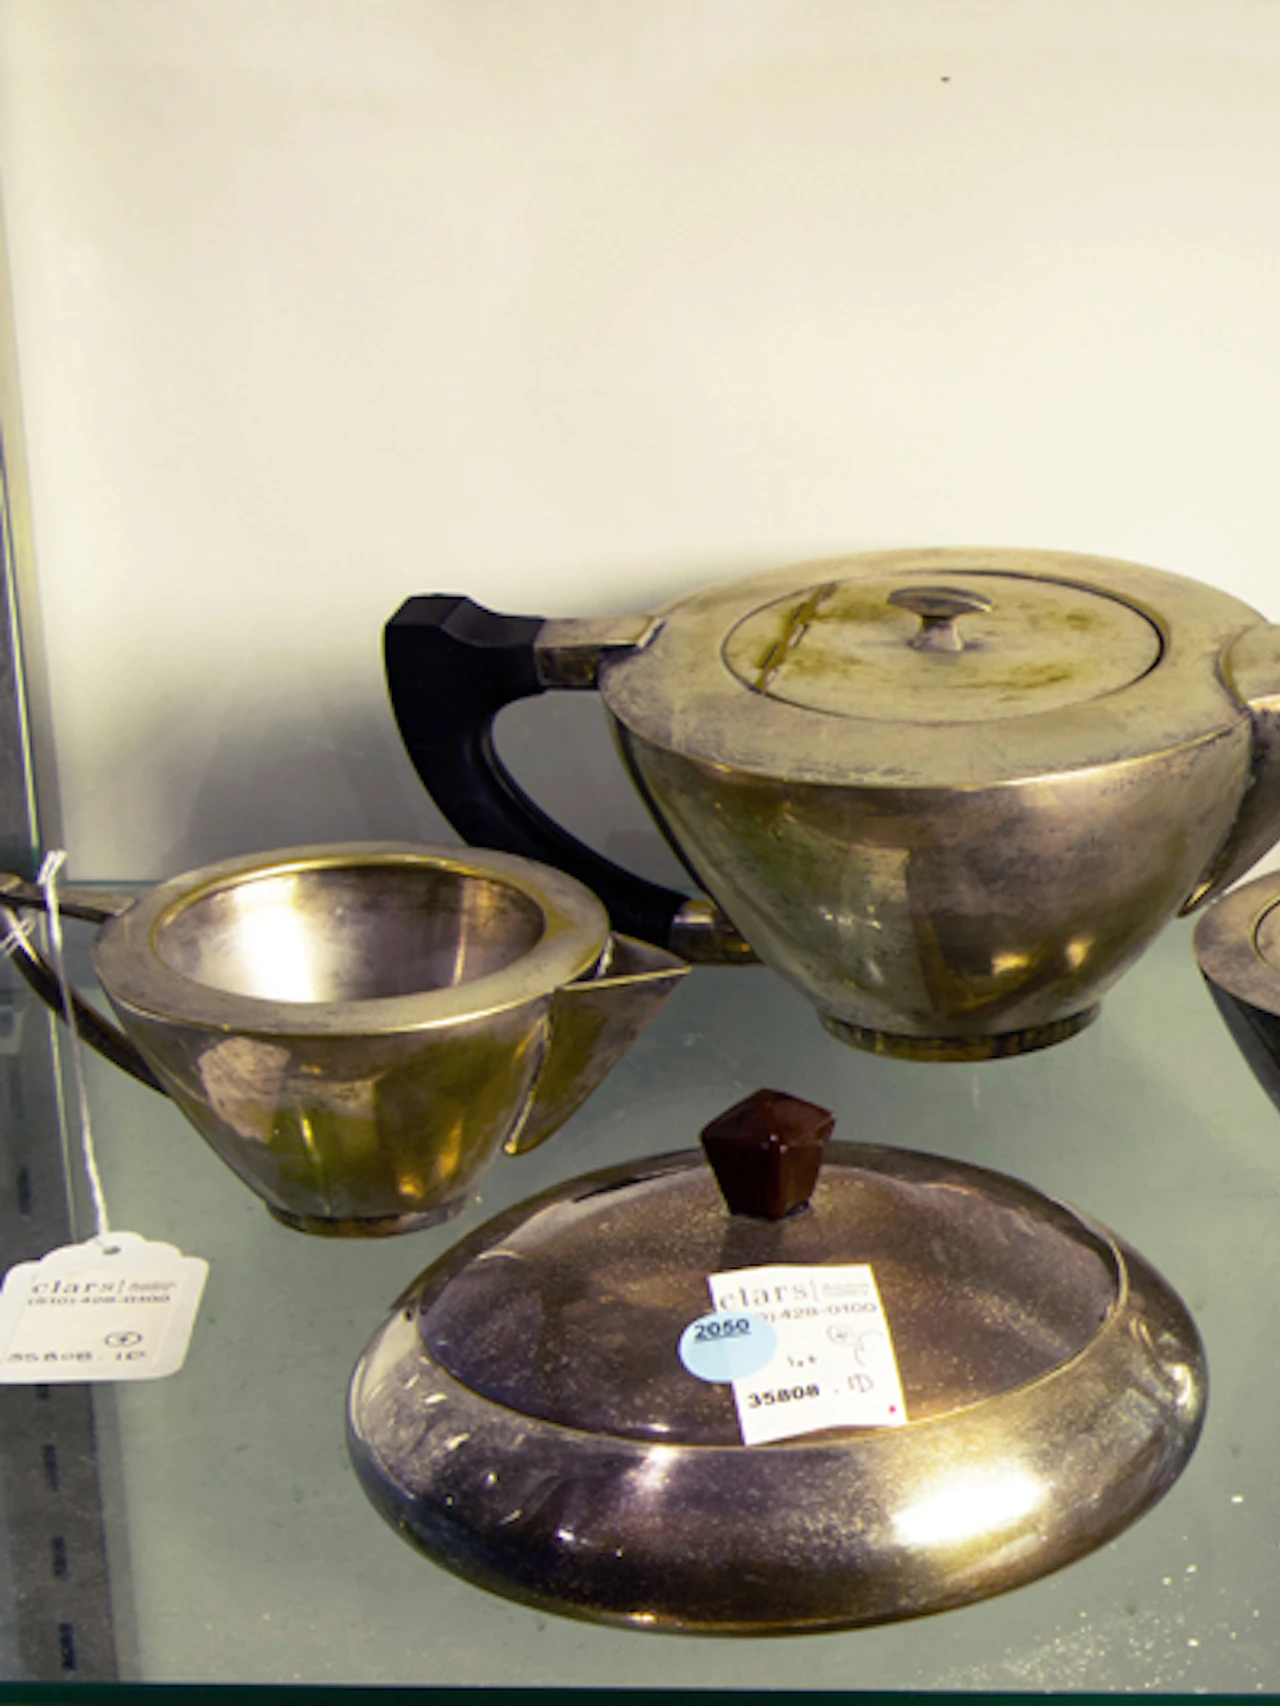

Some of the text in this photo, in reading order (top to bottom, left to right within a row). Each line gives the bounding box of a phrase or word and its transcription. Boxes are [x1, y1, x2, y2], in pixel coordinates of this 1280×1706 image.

[31, 1279, 114, 1294] clars
[720, 1285, 807, 1309] clars
[694, 1318, 751, 1340] 2050
[748, 1384, 820, 1408] 35808
